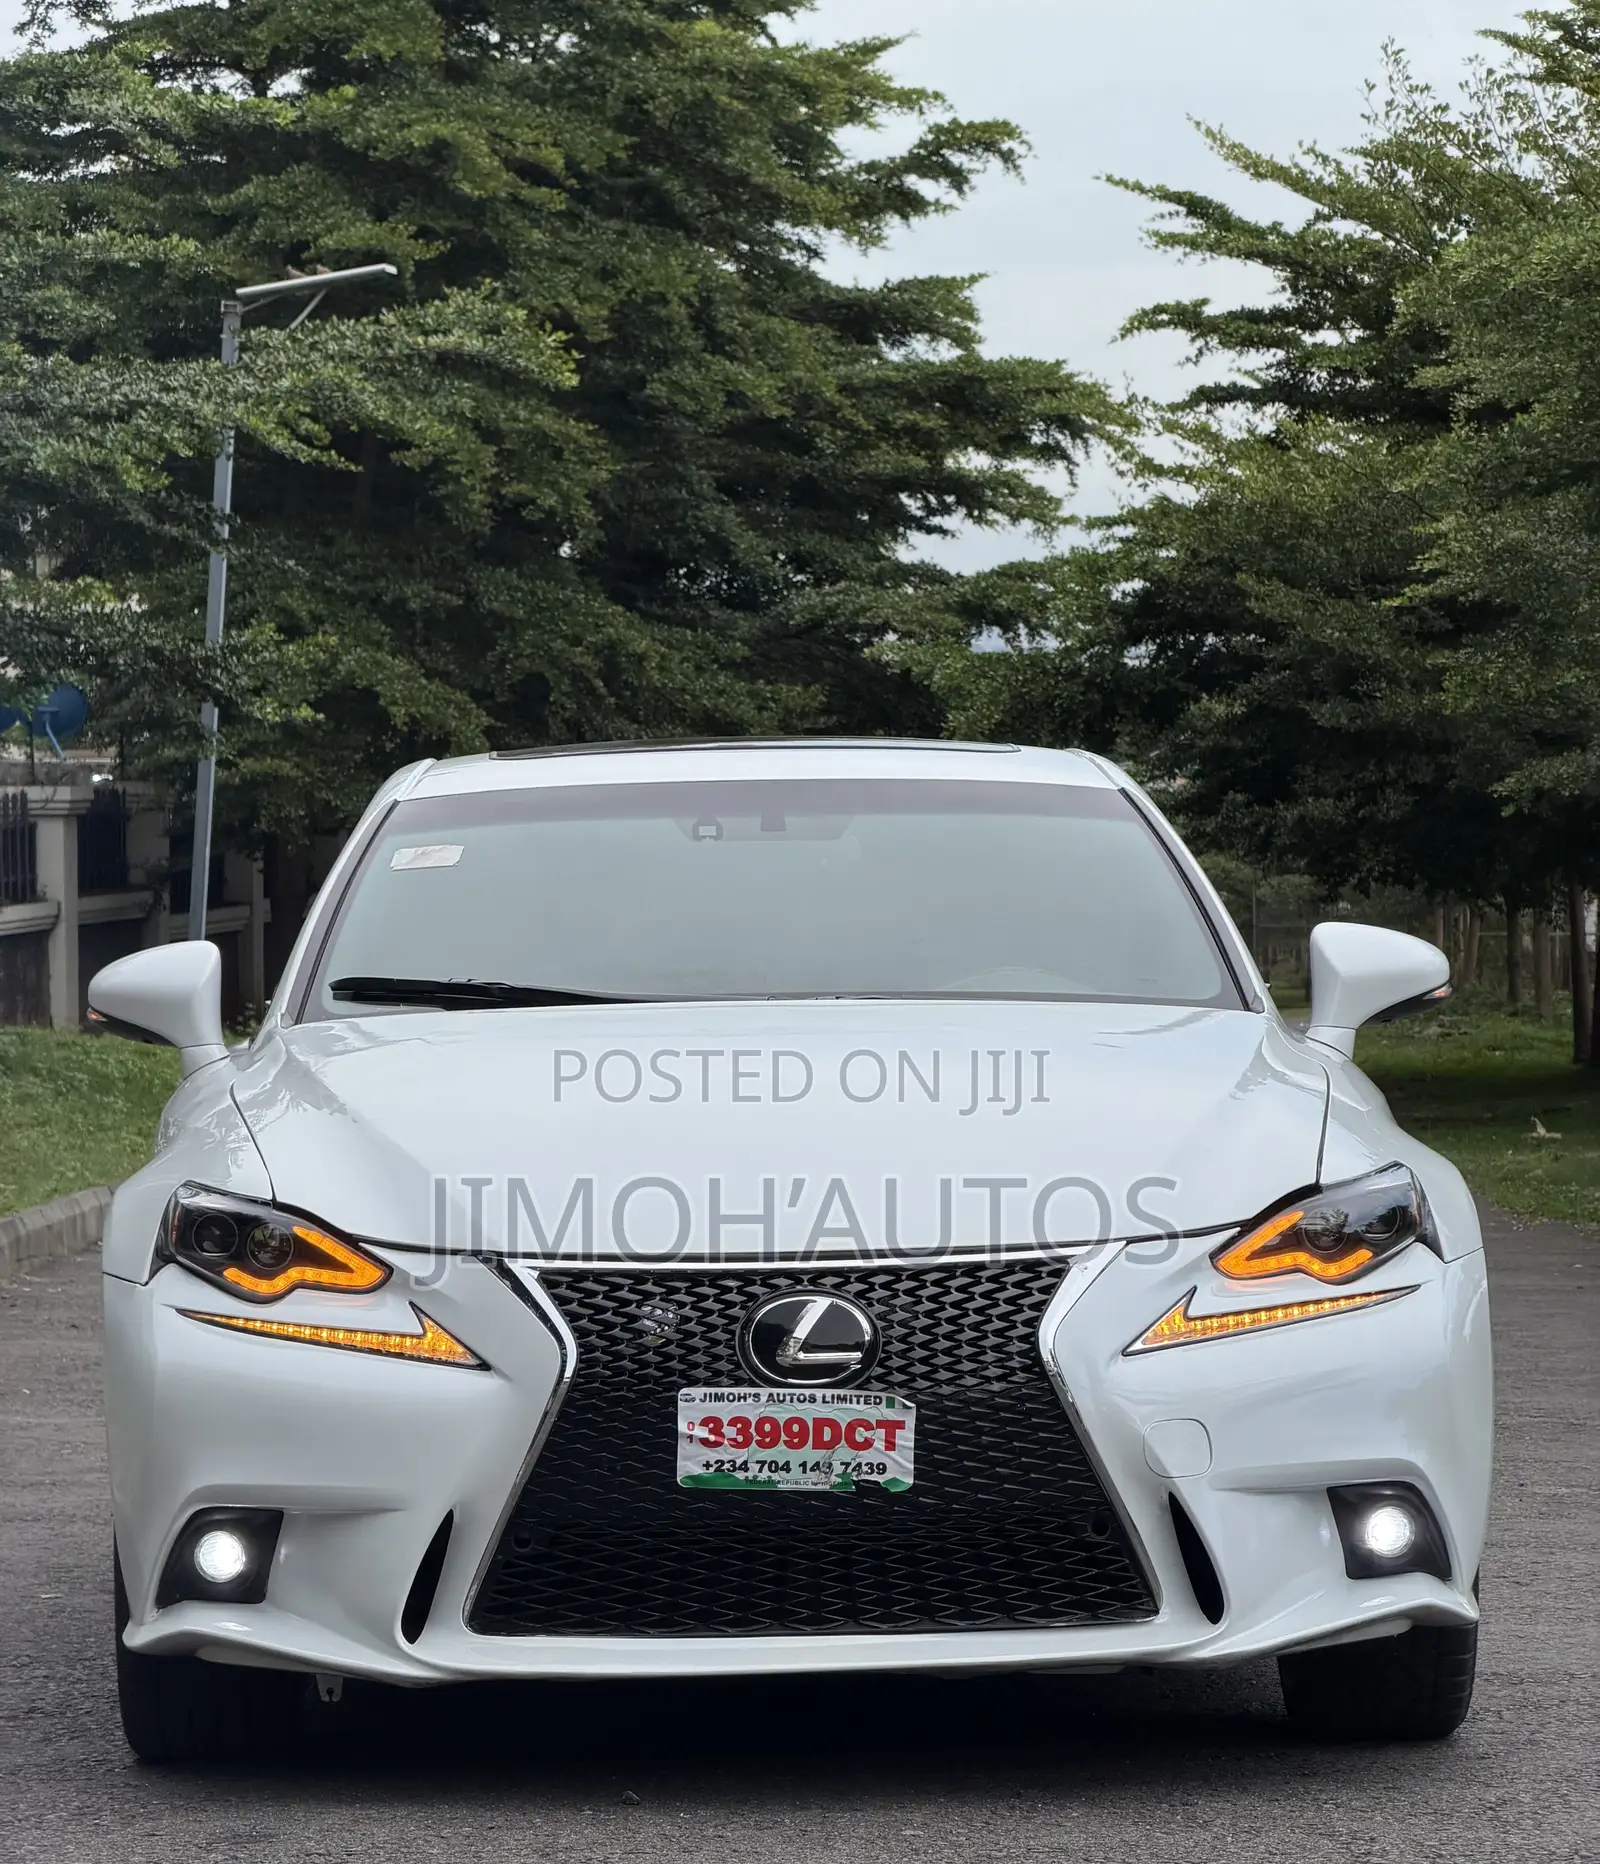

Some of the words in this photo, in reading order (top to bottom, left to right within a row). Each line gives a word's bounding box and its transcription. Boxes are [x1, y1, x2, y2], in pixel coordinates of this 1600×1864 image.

[698, 1392, 762, 1404] JIMOH'S
[765, 1392, 818, 1405] AUTOS
[821, 1394, 884, 1406] LIMITED
[698, 1415, 906, 1451] 3399DCT
[702, 1459, 750, 1474] +234
[755, 1459, 792, 1474] 704
[839, 1460, 888, 1476] 7439
